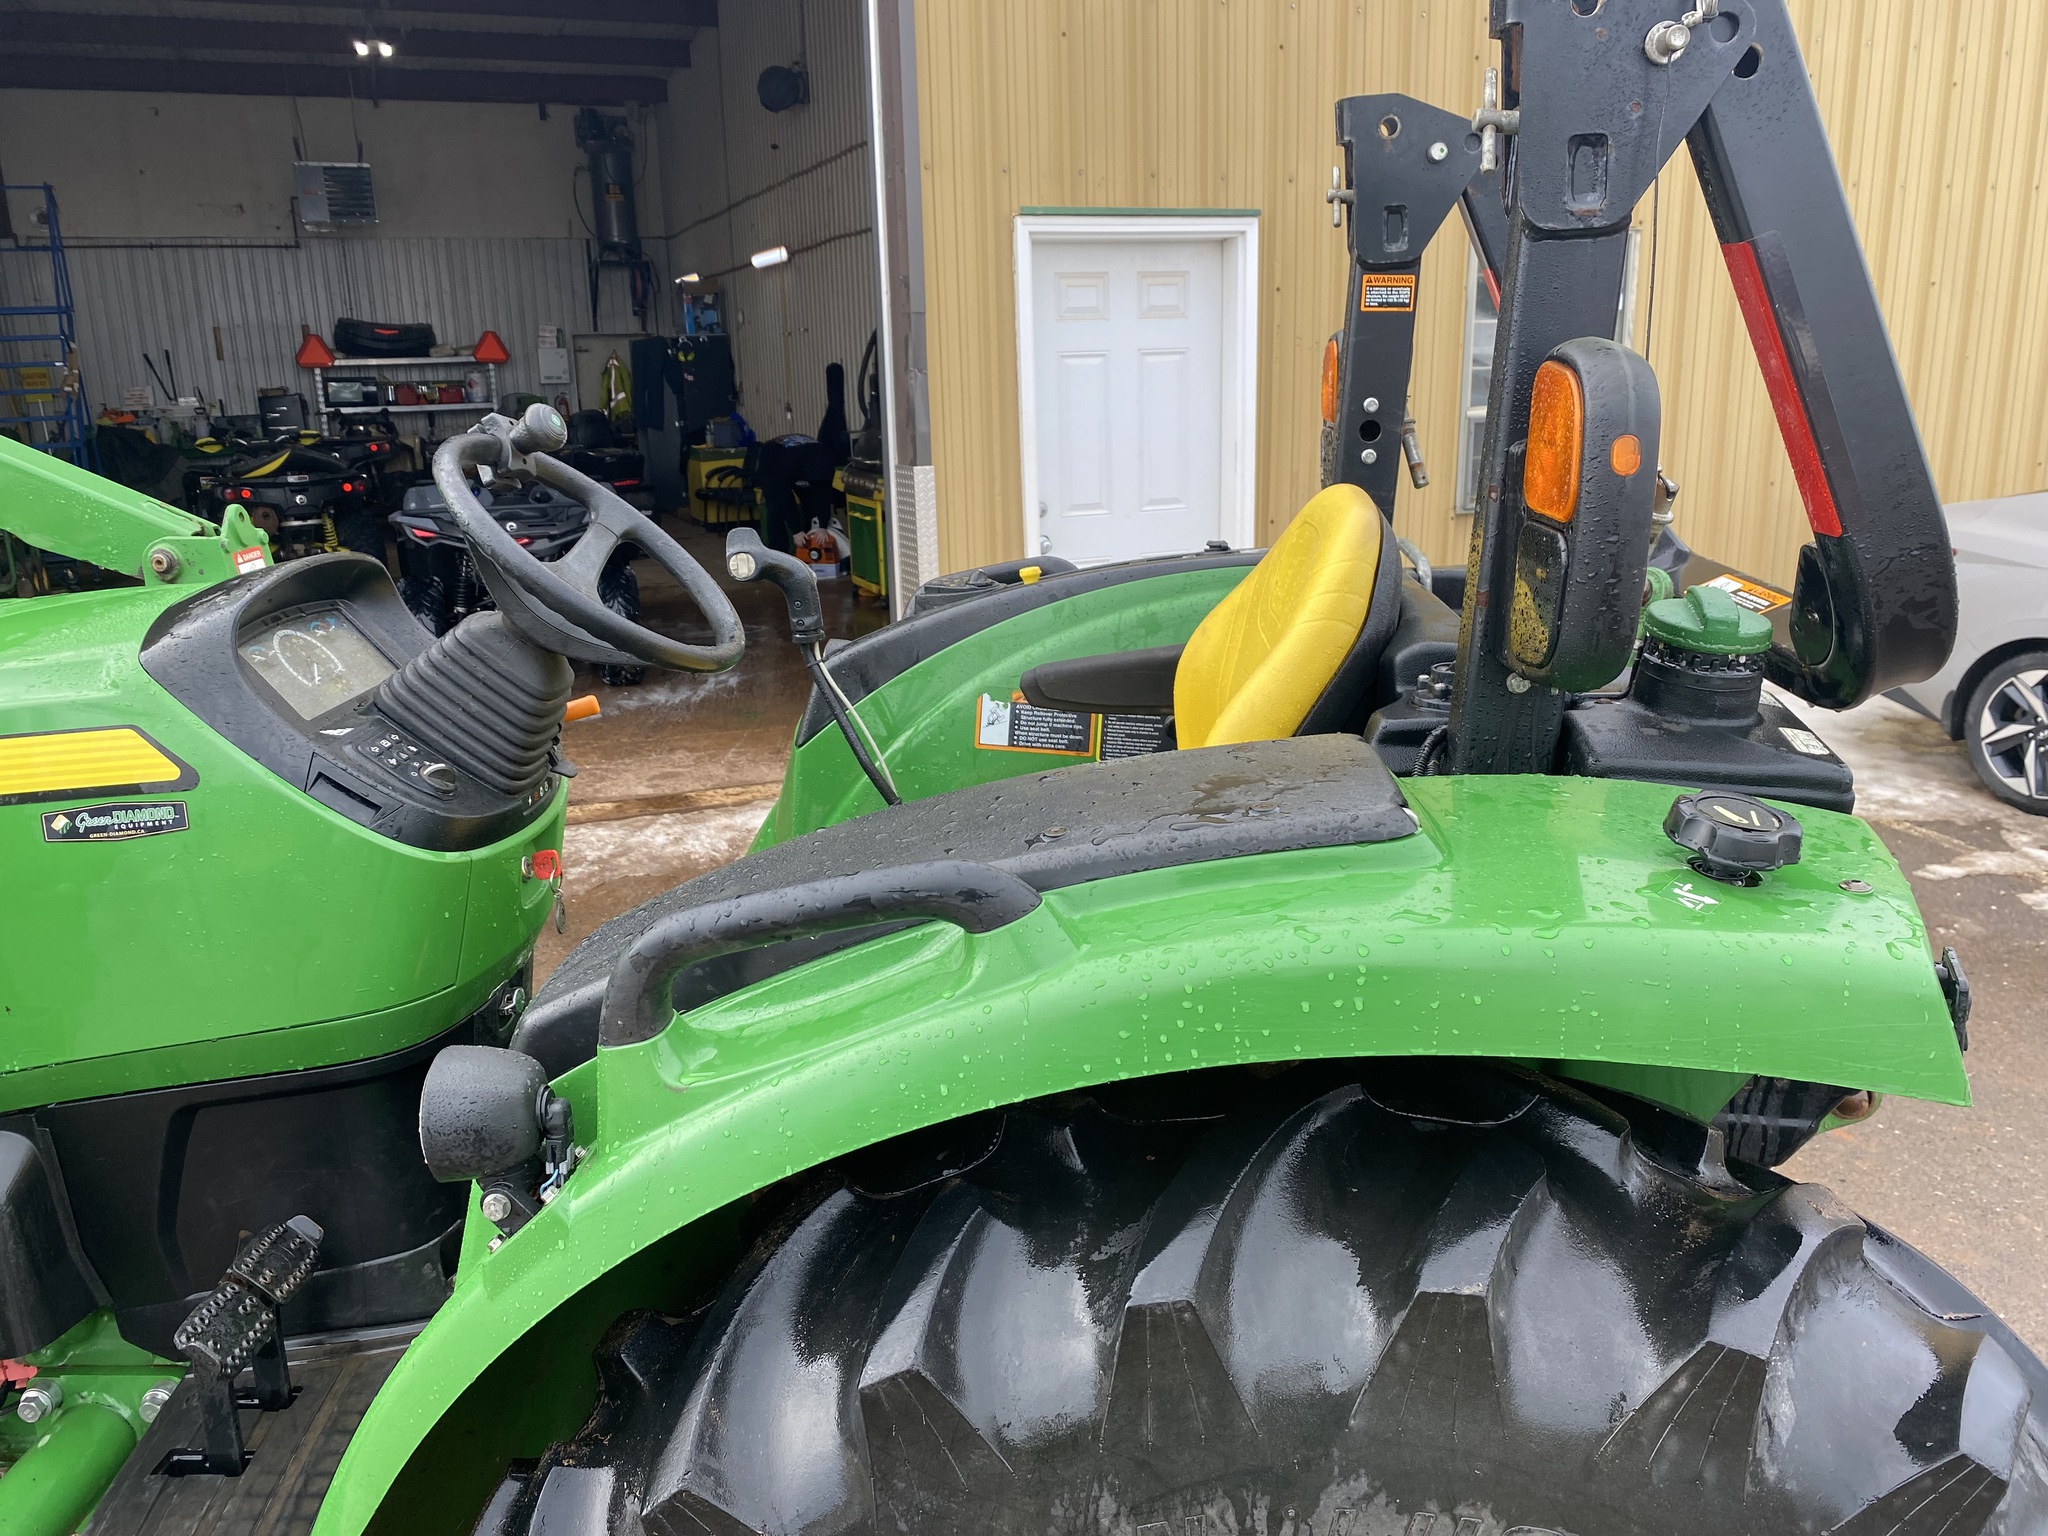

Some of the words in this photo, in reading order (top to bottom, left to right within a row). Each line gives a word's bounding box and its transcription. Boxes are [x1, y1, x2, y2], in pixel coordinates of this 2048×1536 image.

[242, 550, 262, 562] DANGER
[114, 820, 173, 830] EQUIPMENT
[89, 829, 145, 838] GREEN-DIAMOND.CA
